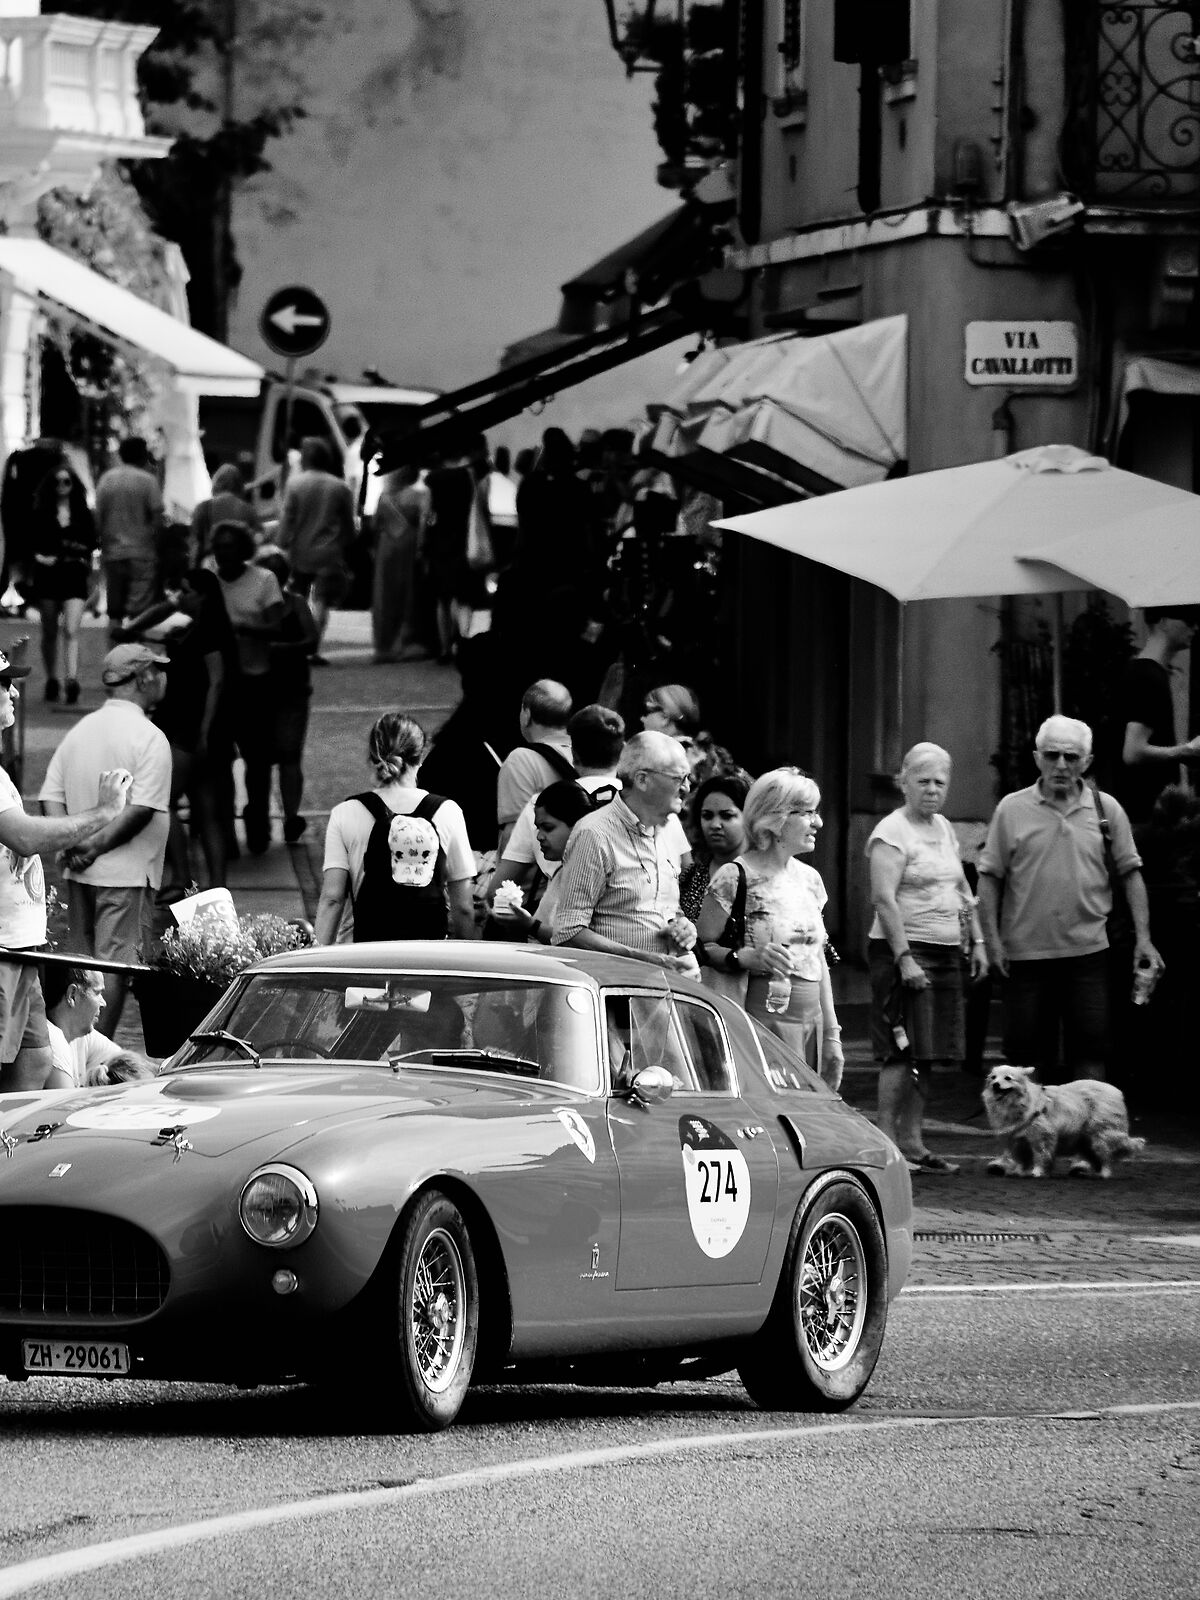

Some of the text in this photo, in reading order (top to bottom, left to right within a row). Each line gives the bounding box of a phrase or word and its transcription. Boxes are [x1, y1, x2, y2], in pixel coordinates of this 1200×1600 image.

[1003, 331, 1040, 349] VIA
[971, 357, 1072, 375] CAVALLOTTI
[697, 1160, 738, 1203] 274
